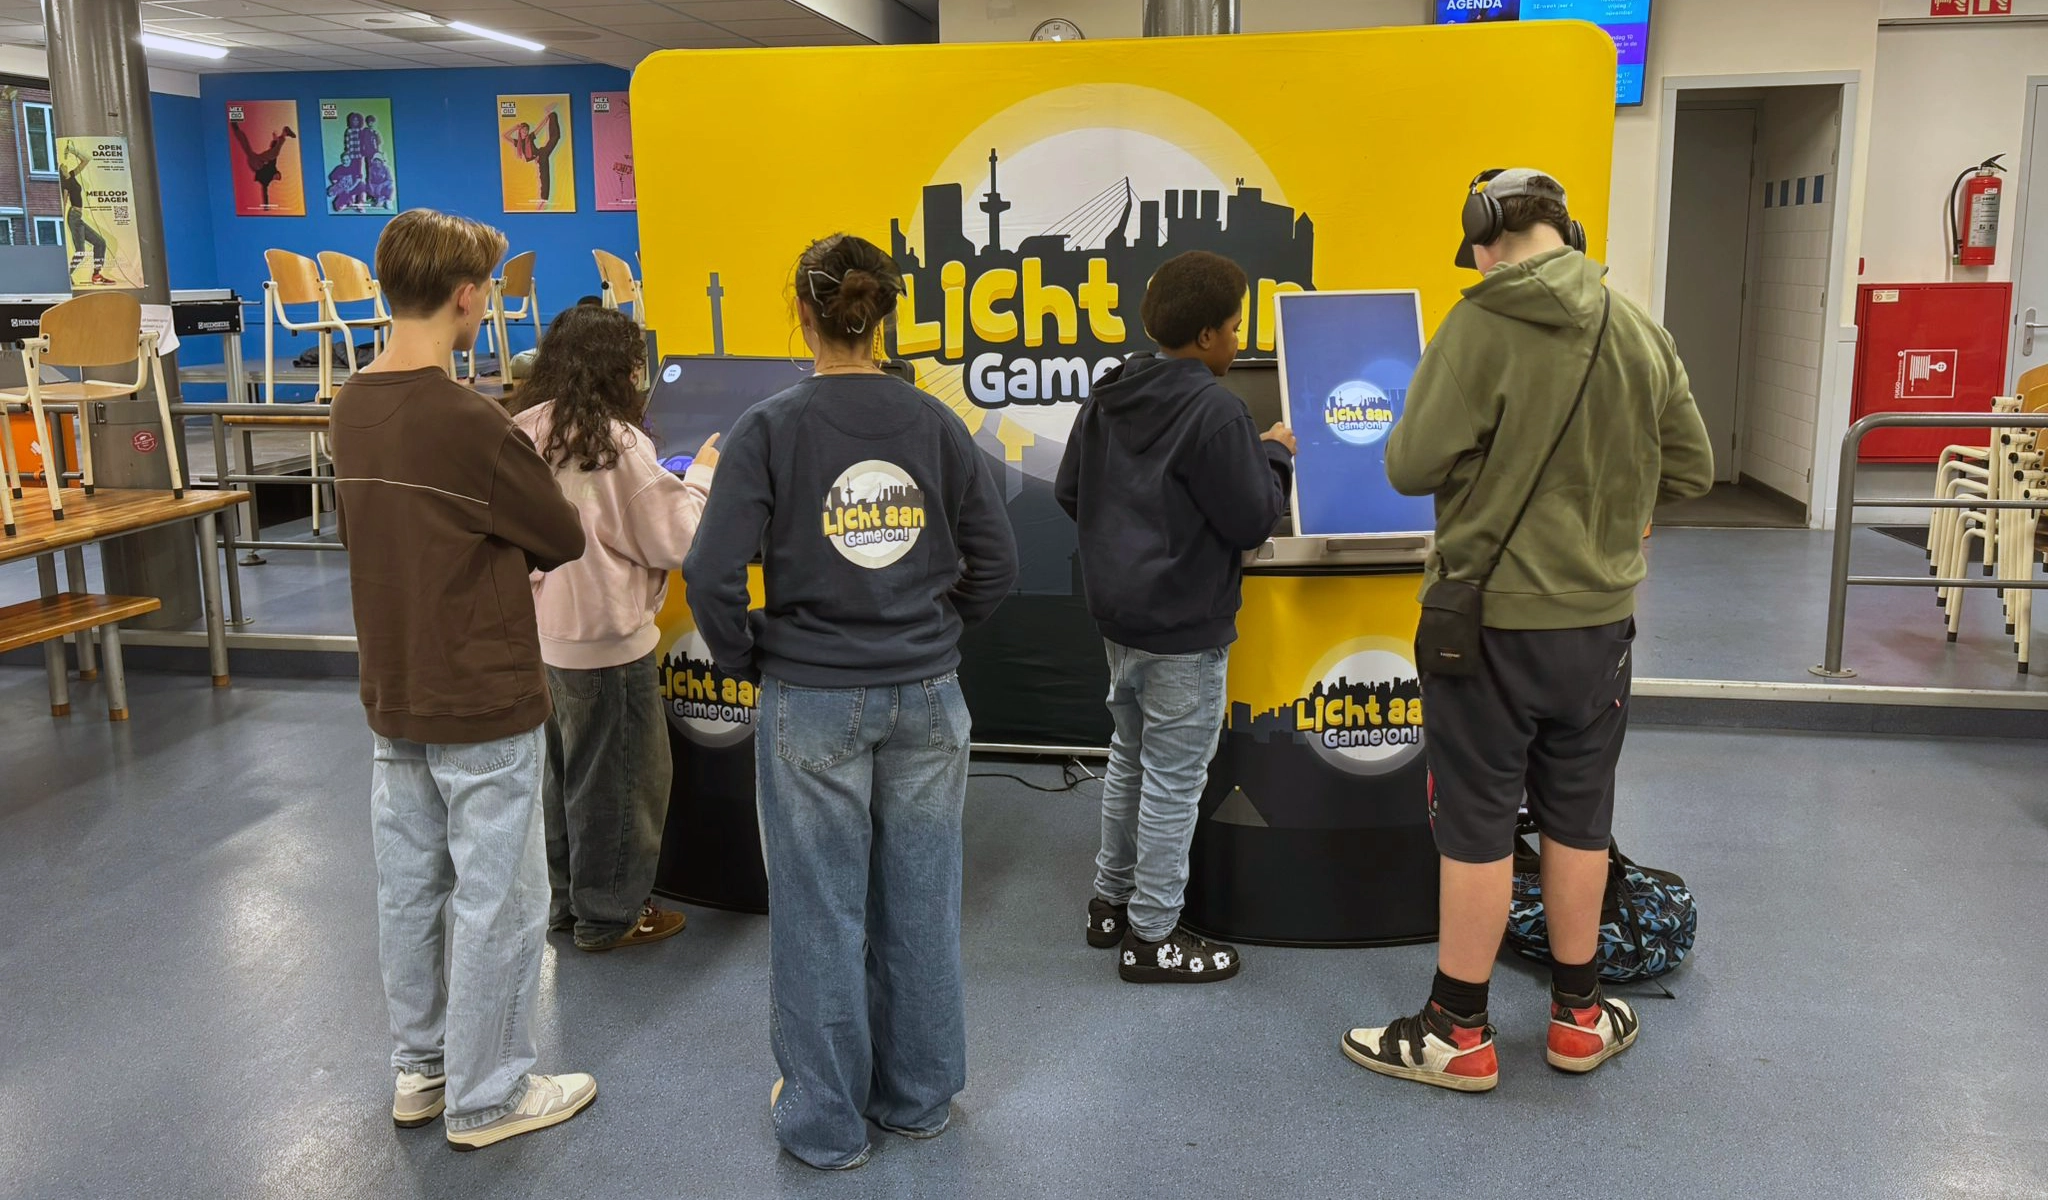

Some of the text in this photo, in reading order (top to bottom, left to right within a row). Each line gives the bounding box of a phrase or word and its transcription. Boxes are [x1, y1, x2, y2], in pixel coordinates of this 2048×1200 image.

[1447, 0, 1502, 10] AGENDA
[896, 256, 1126, 359] Licht
[1324, 406, 1393, 424] Licht aan
[1338, 421, 1382, 431] Game on!
[823, 503, 925, 536] Licht aan
[845, 527, 909, 547] Game on!
[721, 677, 761, 708] aa
[673, 698, 750, 724] Game on!
[1296, 694, 1424, 732] Licht aa
[1323, 724, 1418, 748] Game on!
